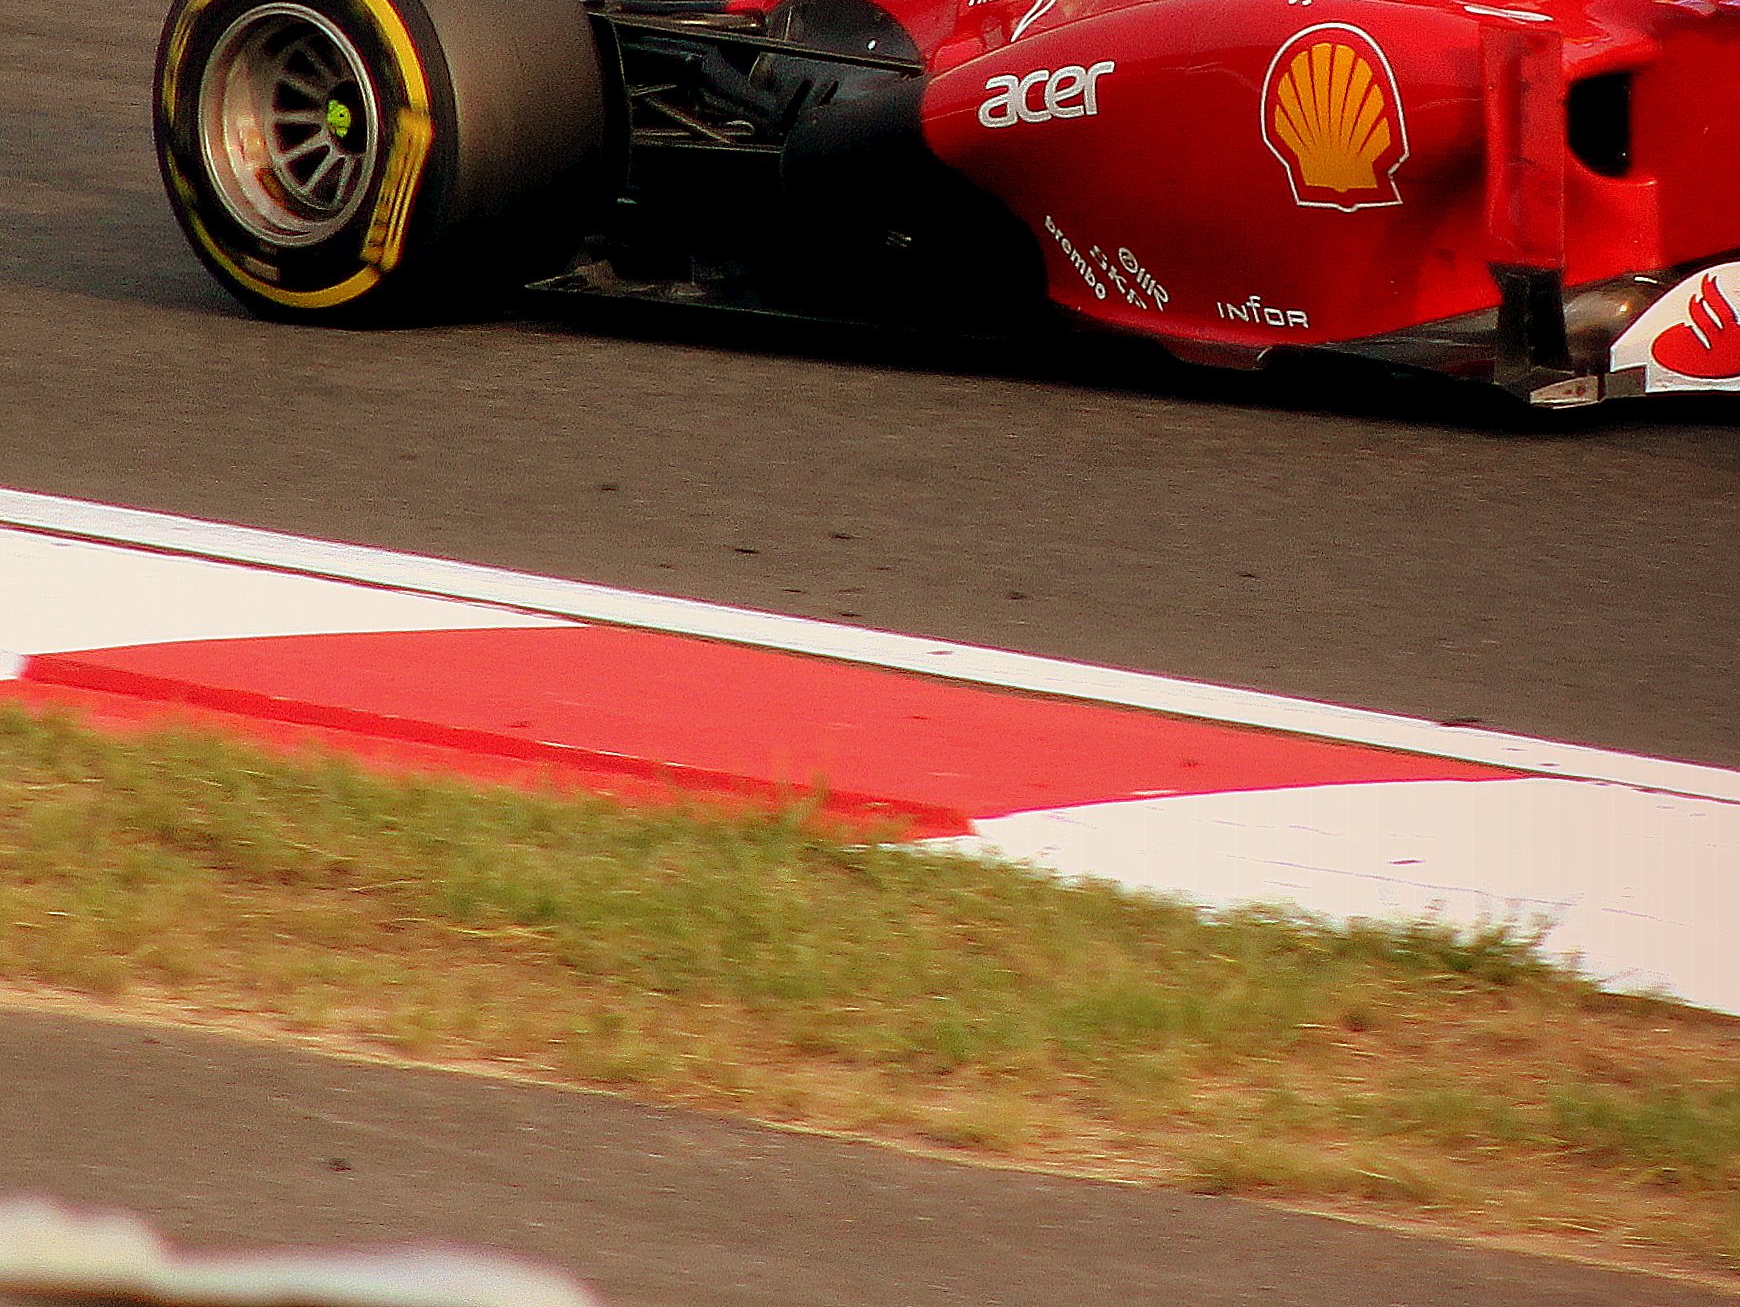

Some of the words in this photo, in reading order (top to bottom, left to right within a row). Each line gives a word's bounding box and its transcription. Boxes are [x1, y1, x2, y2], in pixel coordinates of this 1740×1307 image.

[977, 60, 1116, 129] acer
[1044, 214, 1107, 300] brembo
[1089, 244, 1148, 310] SKF
